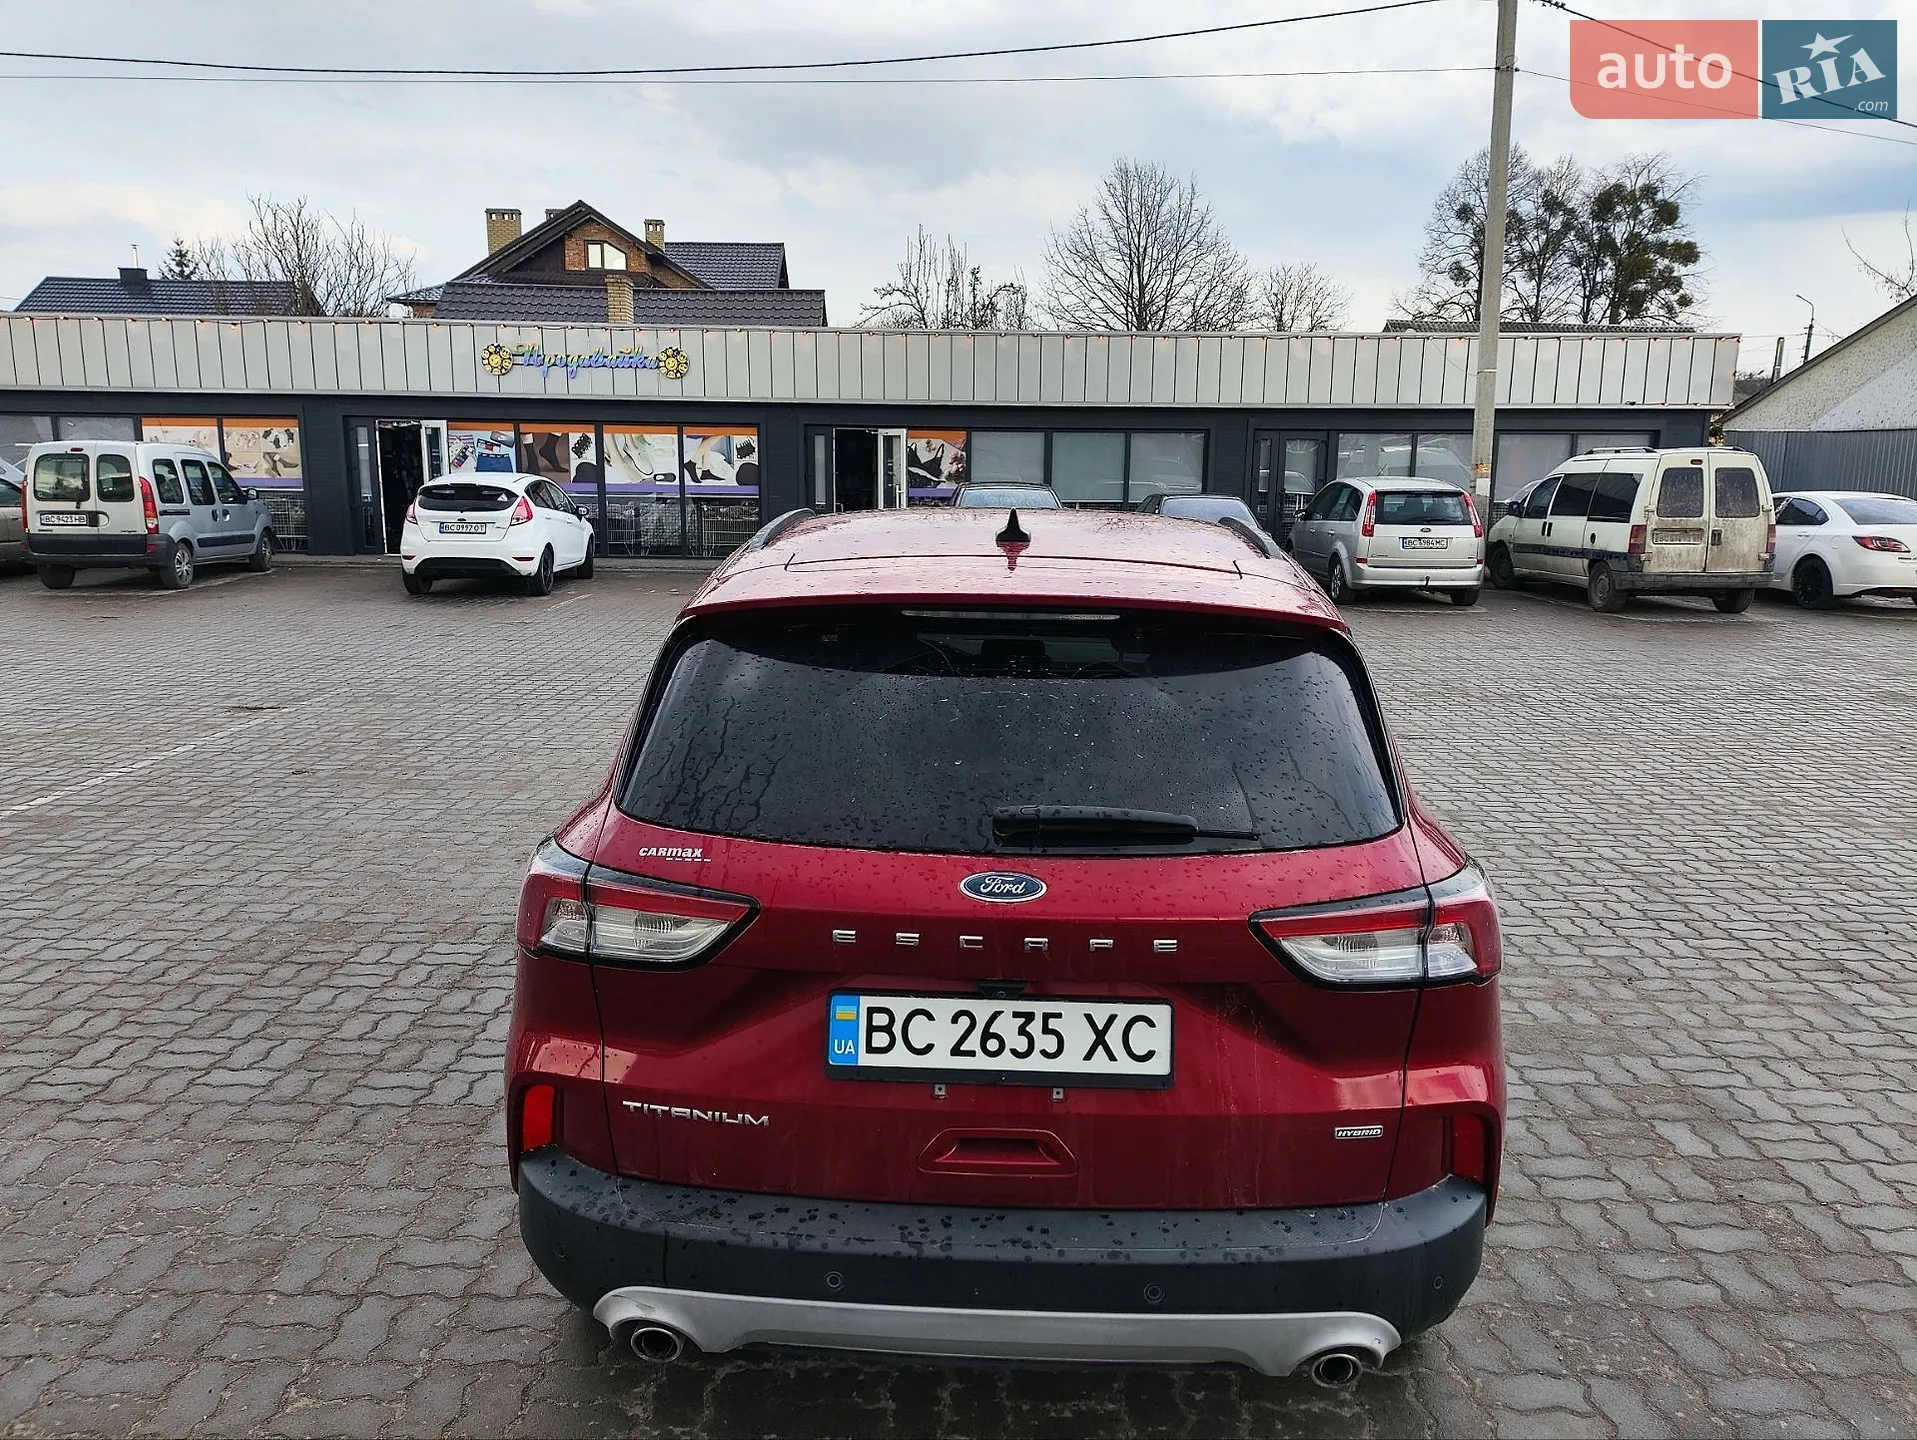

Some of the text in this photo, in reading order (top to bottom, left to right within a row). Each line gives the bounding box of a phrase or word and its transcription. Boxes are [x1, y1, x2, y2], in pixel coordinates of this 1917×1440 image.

[45, 515, 55, 523] BC
[456, 524, 473, 532] 0997
[980, 876, 1027, 894] Ford
[832, 929, 1178, 952] ESCAPE
[865, 1006, 1157, 1063] BC 2635 XC
[834, 1039, 856, 1055] UA
[622, 1100, 770, 1127] TITANIUM
[1337, 1128, 1381, 1137] HYBRID
